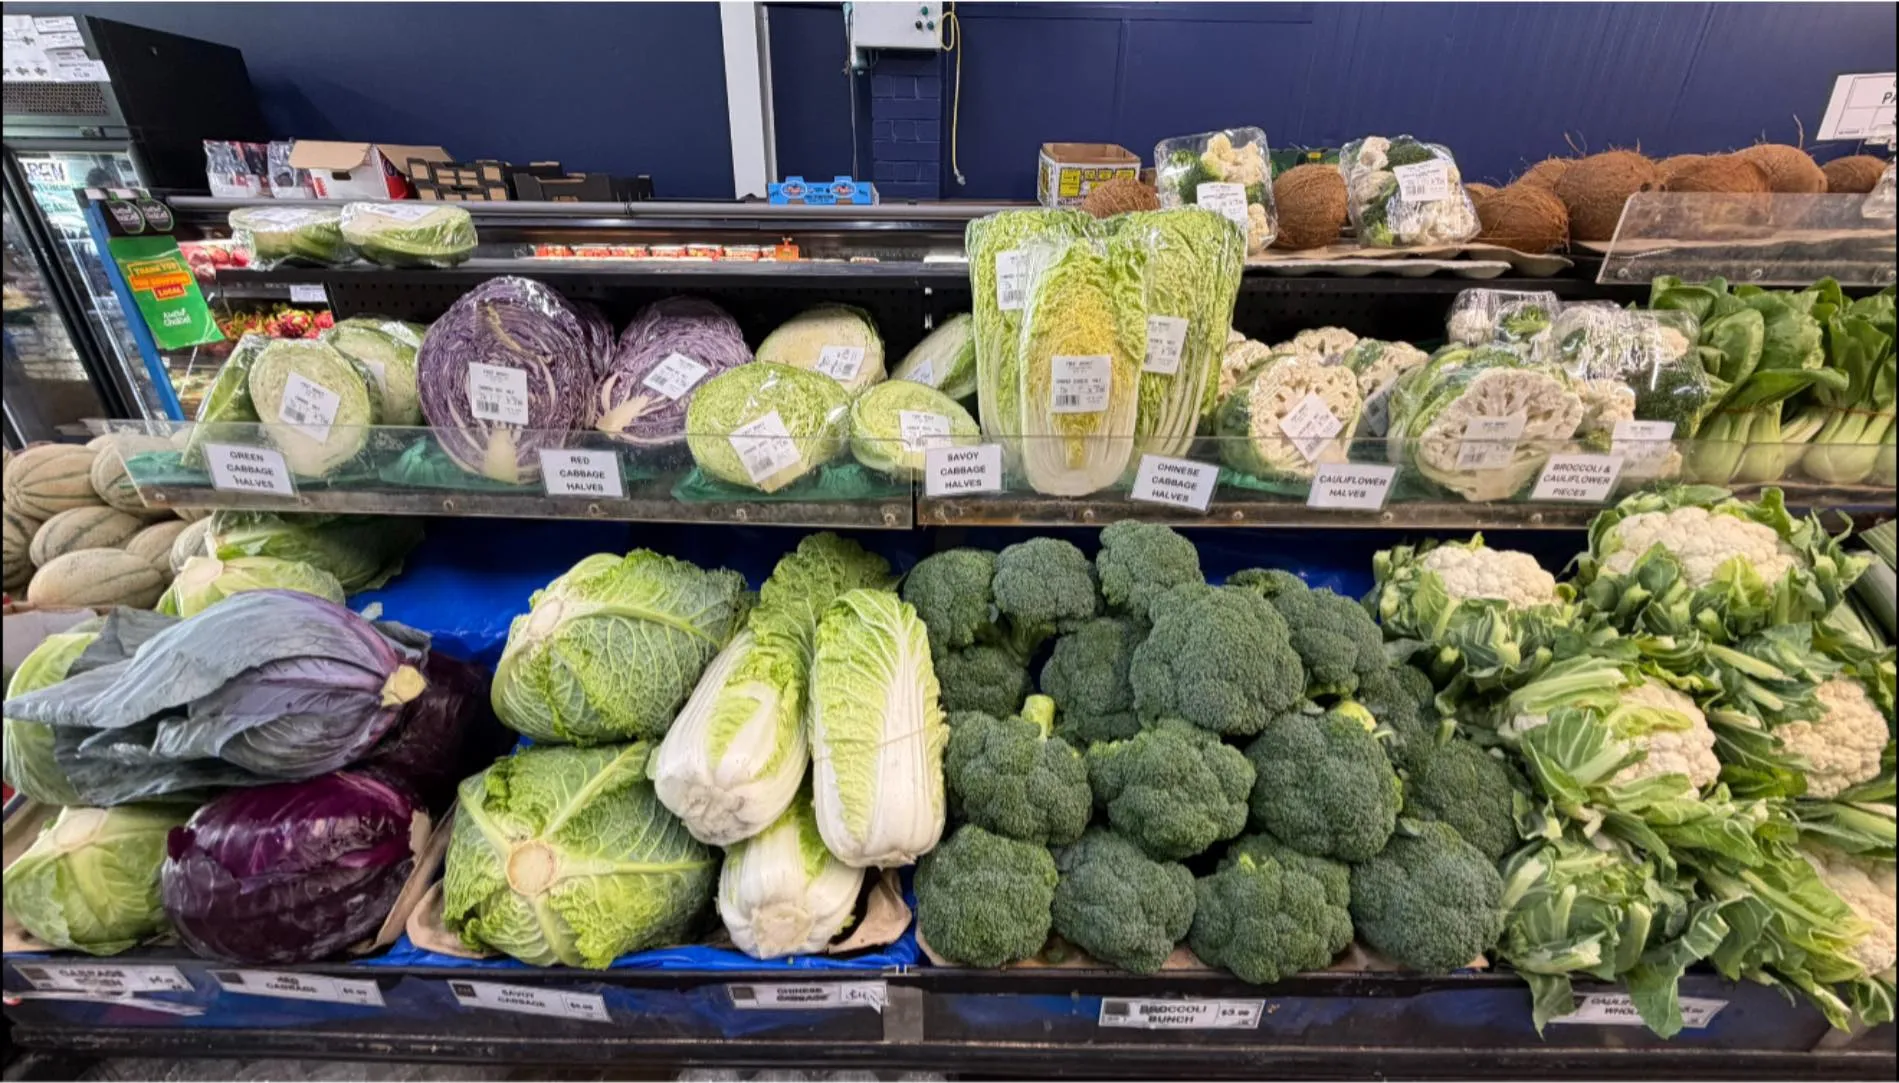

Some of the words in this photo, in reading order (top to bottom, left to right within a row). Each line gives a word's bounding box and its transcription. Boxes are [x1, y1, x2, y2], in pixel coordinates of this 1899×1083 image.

[229, 451, 264, 463] GREEN
[570, 456, 590, 465] RED
[947, 452, 979, 461] SAVOY
[226, 463, 274, 476] CABBAGE
[940, 465, 986, 476] CABBAGE
[1157, 463, 1200, 478] CHINESE
[1552, 463, 1602, 473] BROCCOLI
[559, 469, 605, 479] CABBAGE
[235, 476, 274, 489] HALVES
[945, 479, 982, 489] HALVES
[1151, 475, 1198, 491] CABBAGE
[1320, 474, 1387, 487] CAULIFLOWER
[1543, 474, 1610, 485] CAULIFLOWER
[567, 482, 603, 492] HALVES
[1552, 487, 1587, 497] PIECES
[1151, 489, 1189, 502] HALVES
[1329, 488, 1367, 499] HALVES
[59, 969, 126, 978] CABBAGE
[277, 976, 299, 985] RED
[265, 982, 317, 993] CABBAGE
[501, 989, 535, 998] SAVOY
[498, 995, 546, 1008] CABBAGE
[1139, 1005, 1206, 1014] BROCCOLI
[1605, 1007, 1635, 1015] WHOL
[1148, 1015, 1194, 1024] BUNCH
